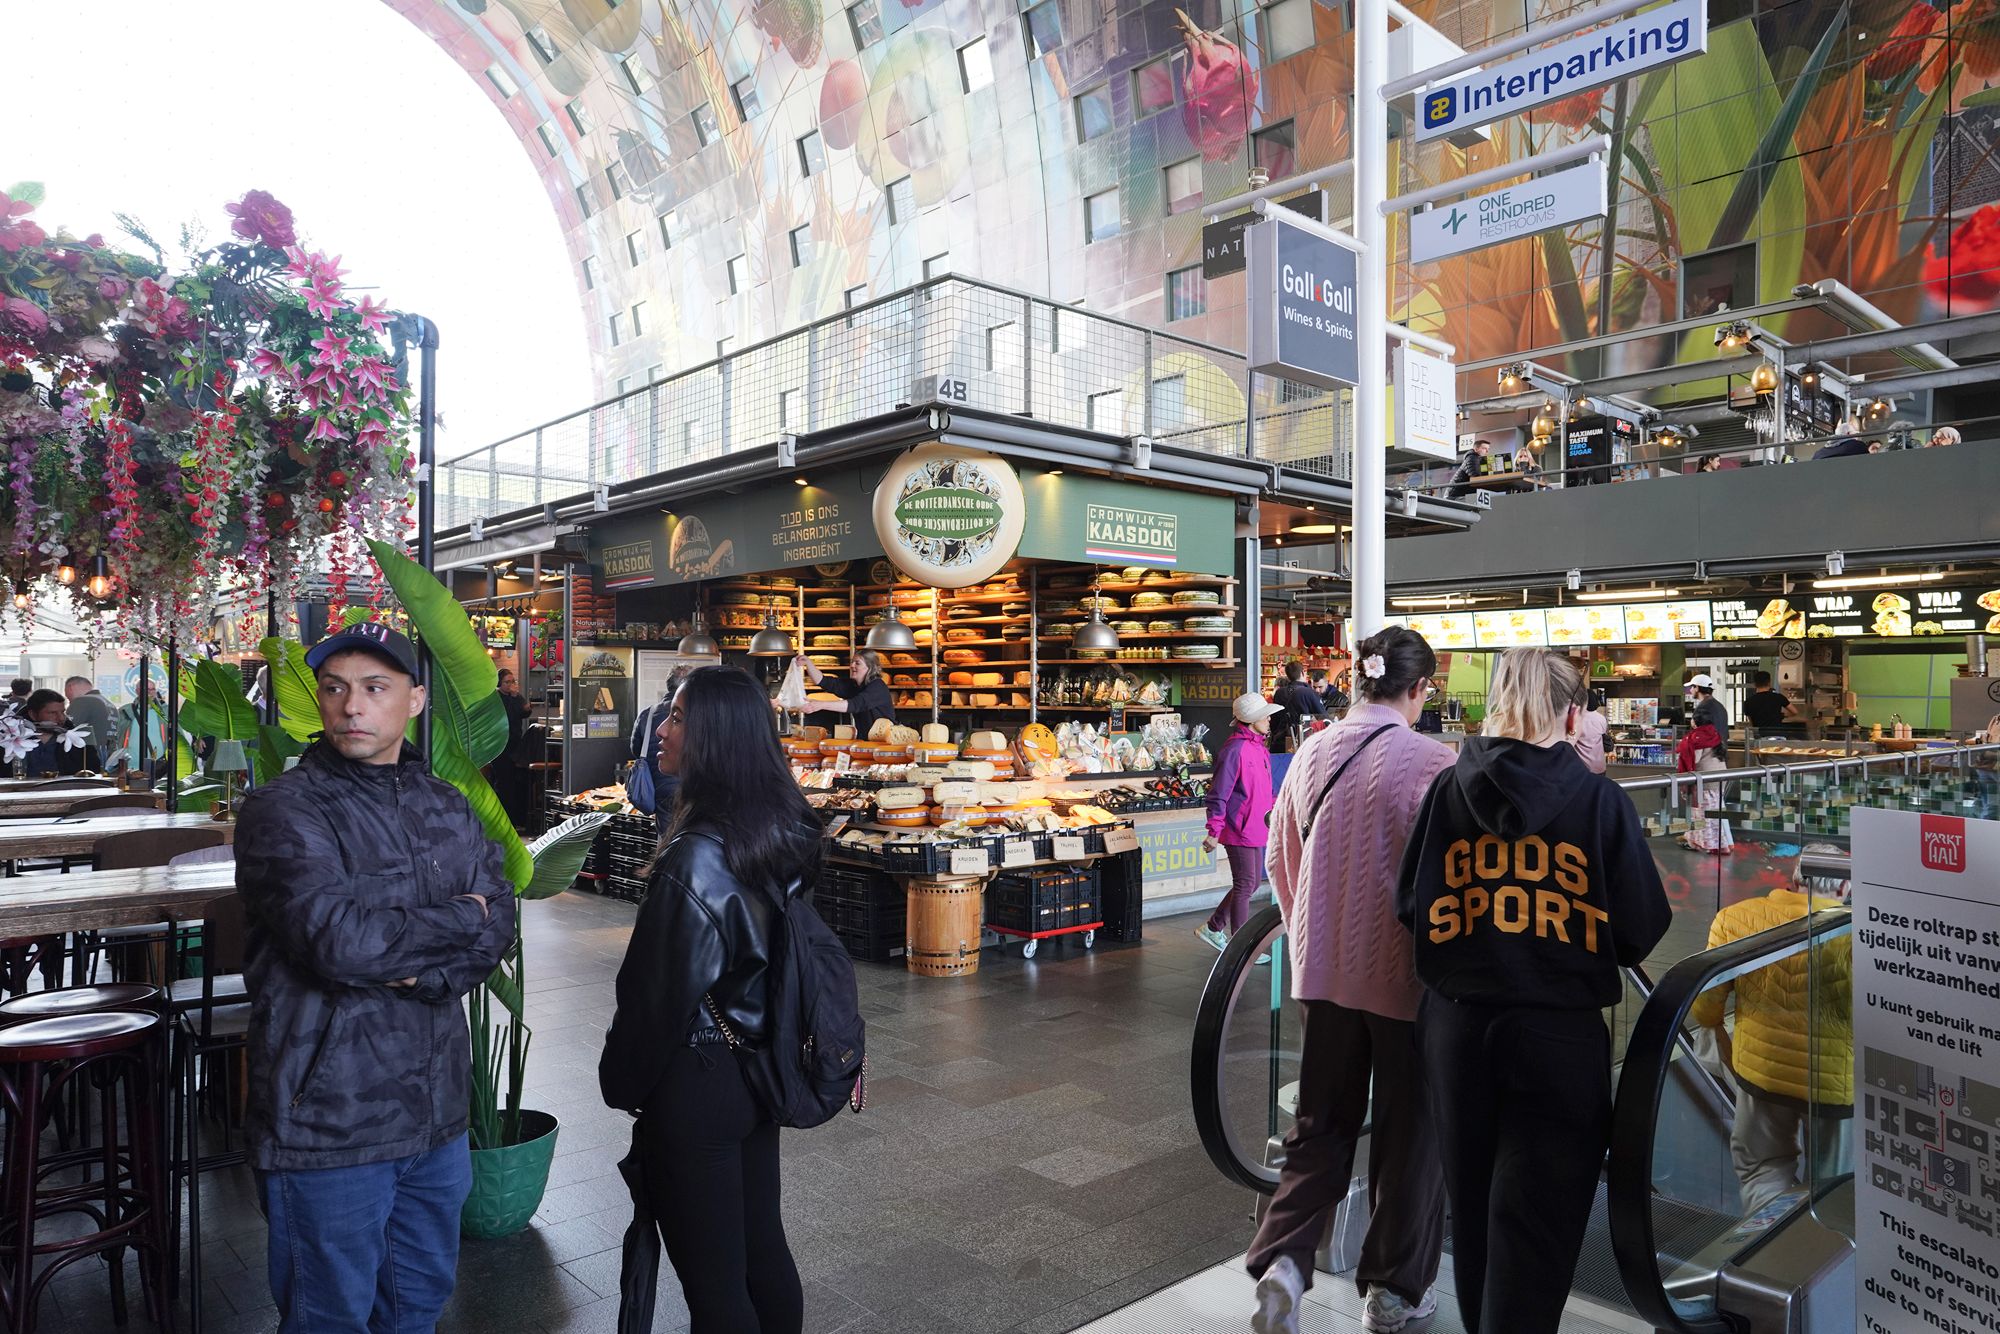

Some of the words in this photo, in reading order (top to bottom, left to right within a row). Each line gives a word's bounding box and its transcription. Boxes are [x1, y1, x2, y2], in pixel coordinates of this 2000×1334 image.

[1464, 17, 1690, 114] Interparking
[1479, 192, 1511, 212] ONE
[1480, 194, 1556, 227] HUNDRED
[1480, 209, 1556, 239] RESTROOMS
[1284, 306, 1313, 327] Wines
[1315, 316, 1323, 331] &
[1326, 320, 1353, 340] Spirits
[1410, 361, 1428, 386] DE
[939, 378, 966, 401] 48
[1411, 384, 1442, 411] TIJD
[1412, 408, 1447, 434] TRAP
[1569, 428, 1603, 438] MAXIMUM
[904, 502, 912, 510] DE
[1478, 492, 1490, 505] 46
[781, 512, 802, 527] TIJD
[805, 508, 815, 522] IS
[818, 504, 839, 520] ONS
[1090, 508, 1155, 526] CROMWIJK
[772, 522, 852, 546] BELANGRIJKSTE
[1090, 522, 1174, 547] KAASDOK
[604, 546, 640, 560] CROMWIJK
[605, 554, 652, 575] KAASDOK
[783, 542, 841, 562] INGREDIËNT
[1814, 596, 1853, 611] WRAP
[1918, 592, 1962, 607] WRAP
[1924, 832, 1963, 846] MARKT
[1445, 834, 1588, 896] GODS
[1929, 842, 1958, 866] HAL
[1428, 886, 1608, 954] SPORT
[1868, 906, 1910, 928] Deze
[1914, 918, 1978, 945] roltrap
[1859, 929, 1922, 957] tijdelijk
[1927, 944, 1952, 962] uit
[1874, 958, 2000, 999] werkzaamhed
[1866, 992, 1876, 1006] U
[1880, 996, 1913, 1017] kunt
[1916, 1008, 1976, 1034] gebruik
[1907, 1026, 1934, 1043] van
[1937, 1034, 1956, 1050] de
[1960, 1038, 1982, 1058] lift
[1880, 1210, 1916, 1240] This
[1920, 1234, 1999, 1280] escalato
[1864, 1277, 1896, 1304] due
[1900, 1294, 1918, 1316] to
[1890, 1268, 1920, 1292] out
[1925, 1286, 1944, 1304] of
